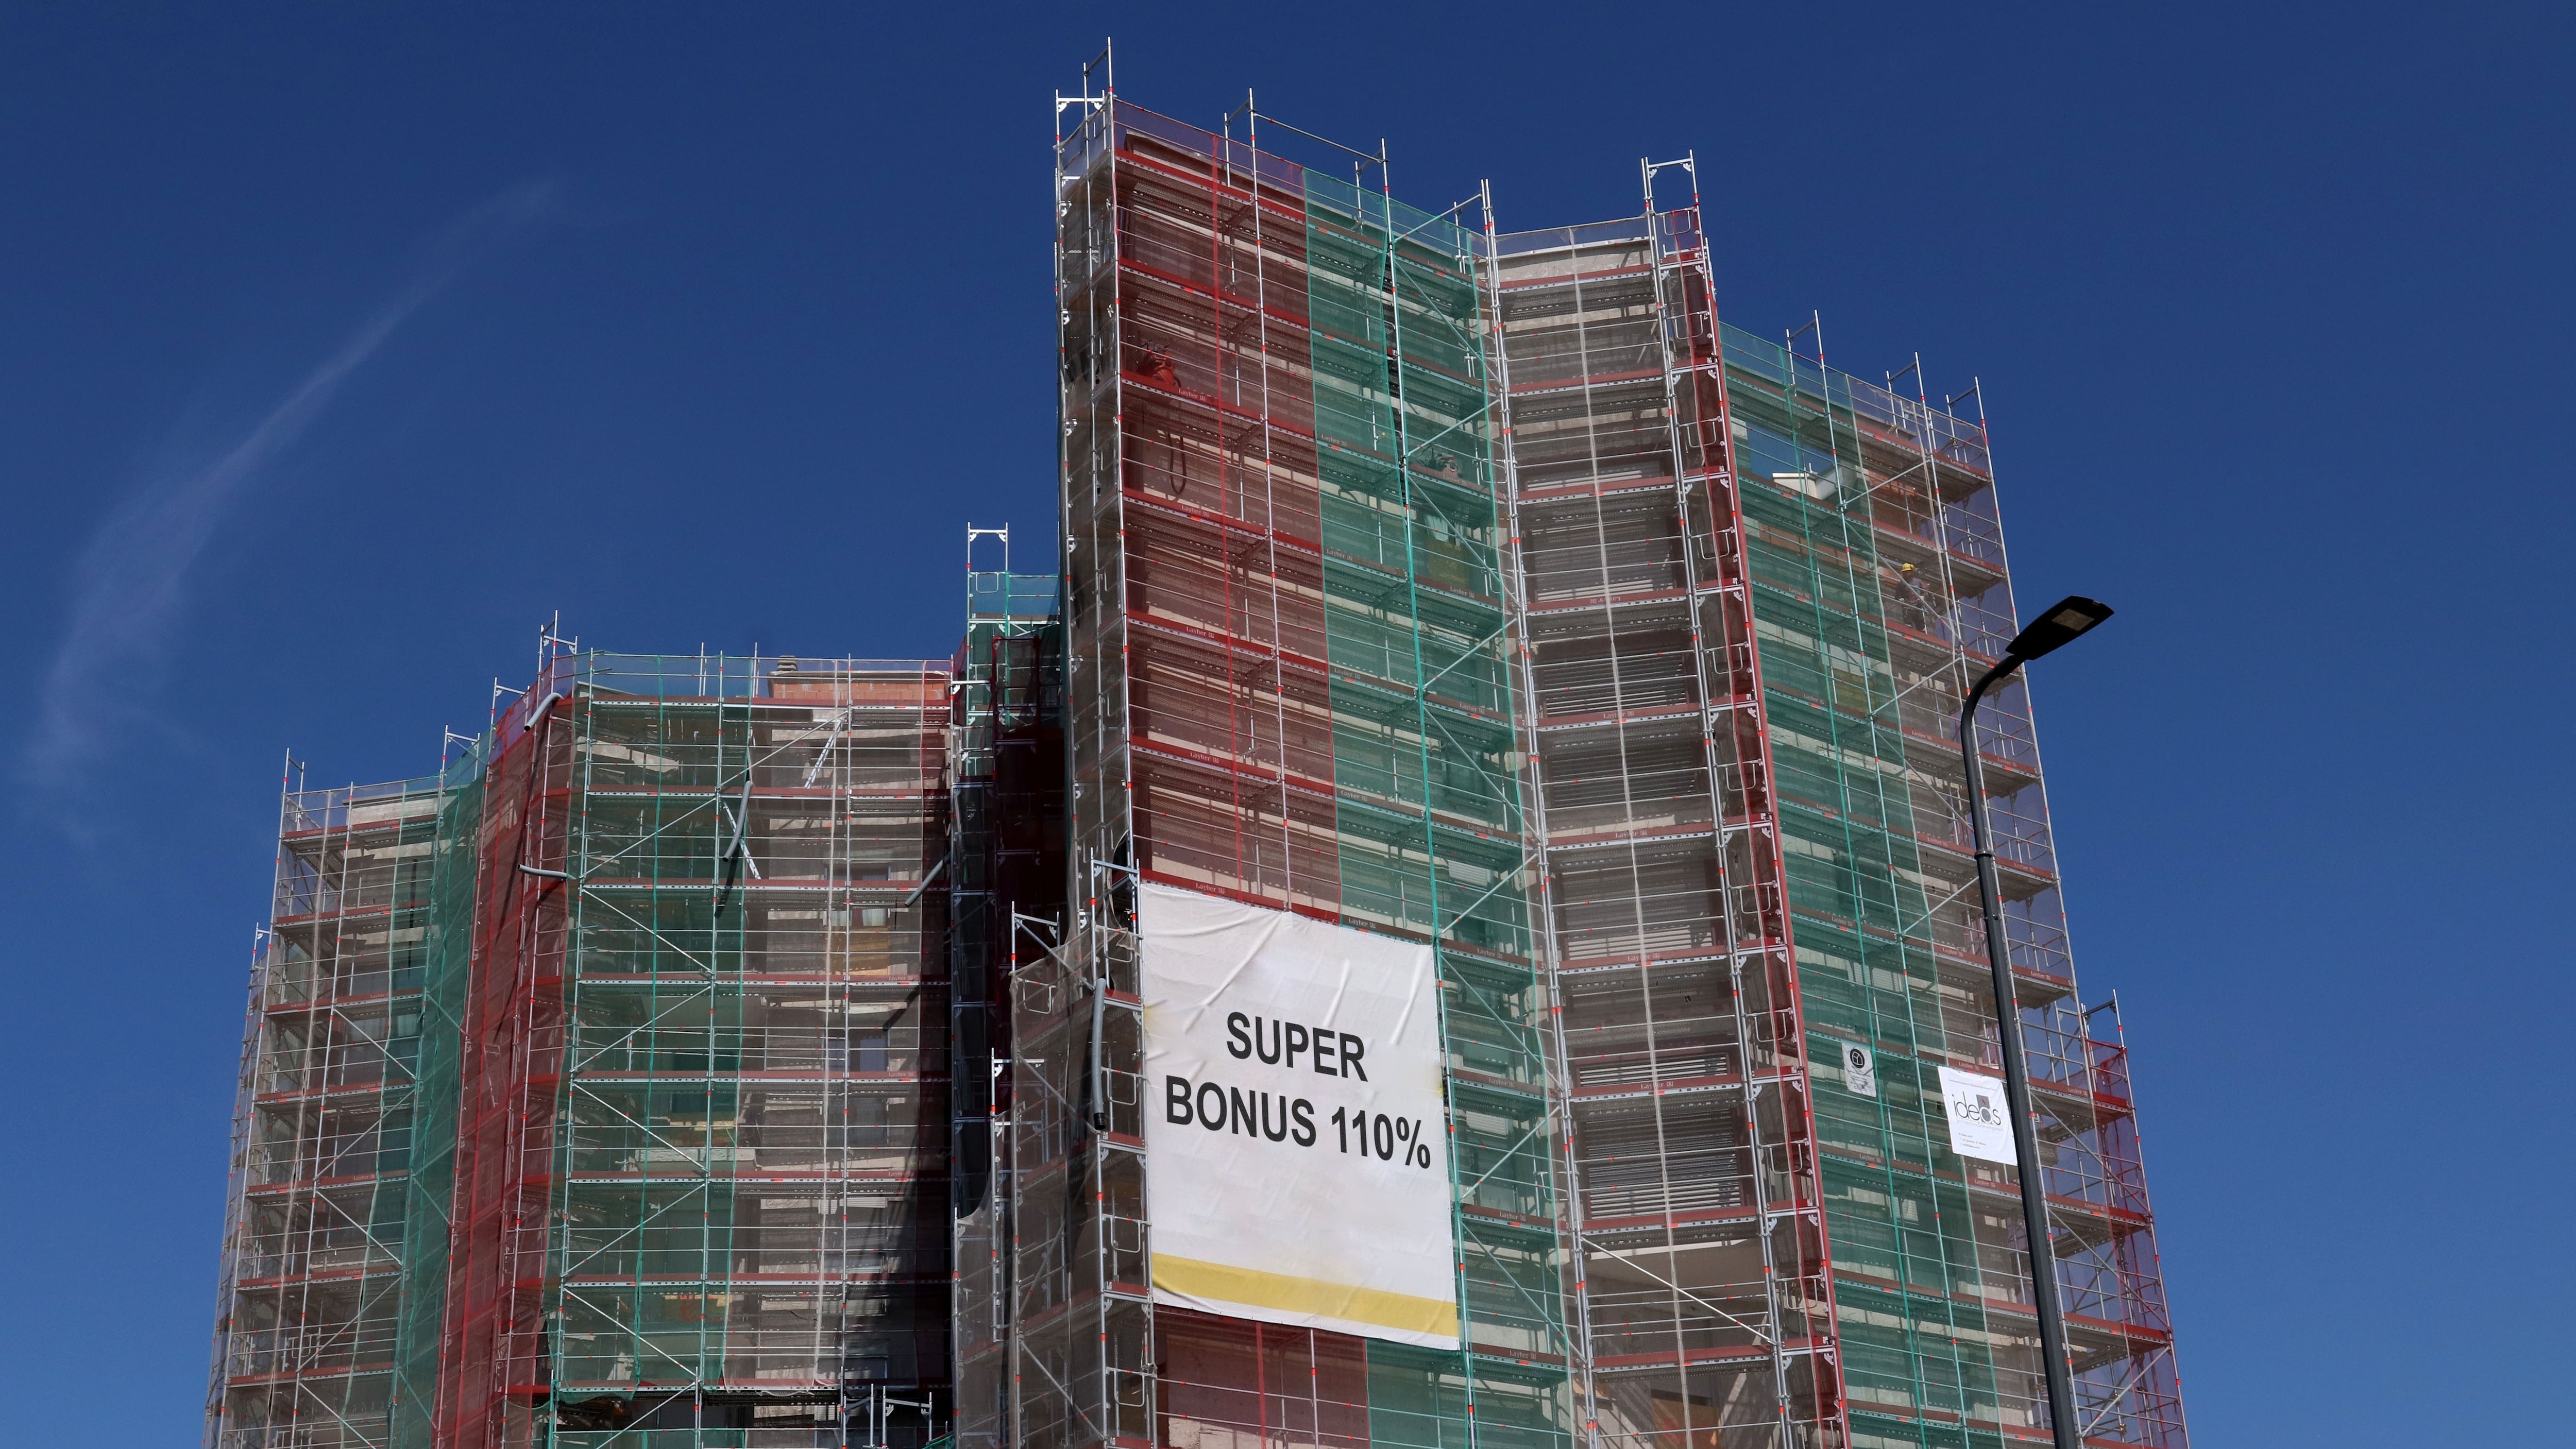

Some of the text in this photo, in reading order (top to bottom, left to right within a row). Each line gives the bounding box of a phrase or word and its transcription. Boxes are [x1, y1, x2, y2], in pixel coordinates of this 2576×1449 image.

[1179, 388, 1198, 399] Layher
[1182, 505, 1201, 515] Layher
[1327, 548, 1344, 558] Layher
[1450, 587, 1467, 596] Layher
[1187, 626, 1206, 636] Layher
[1460, 703, 1477, 711] Layher
[1191, 752, 1211, 761] Layher
[1341, 790, 1360, 799] Layher
[1196, 882, 1216, 892] Layher
[1349, 917, 1368, 927] Layher
[1477, 948, 1495, 957] Layher
[1226, 1011, 1368, 1082] SUPER
[1952, 1091, 2001, 1125] ideas
[1166, 1075, 1431, 1169] BONUS 110%
[1500, 1212, 1517, 1220] Layher
[1510, 1351, 1529, 1359] Layher
